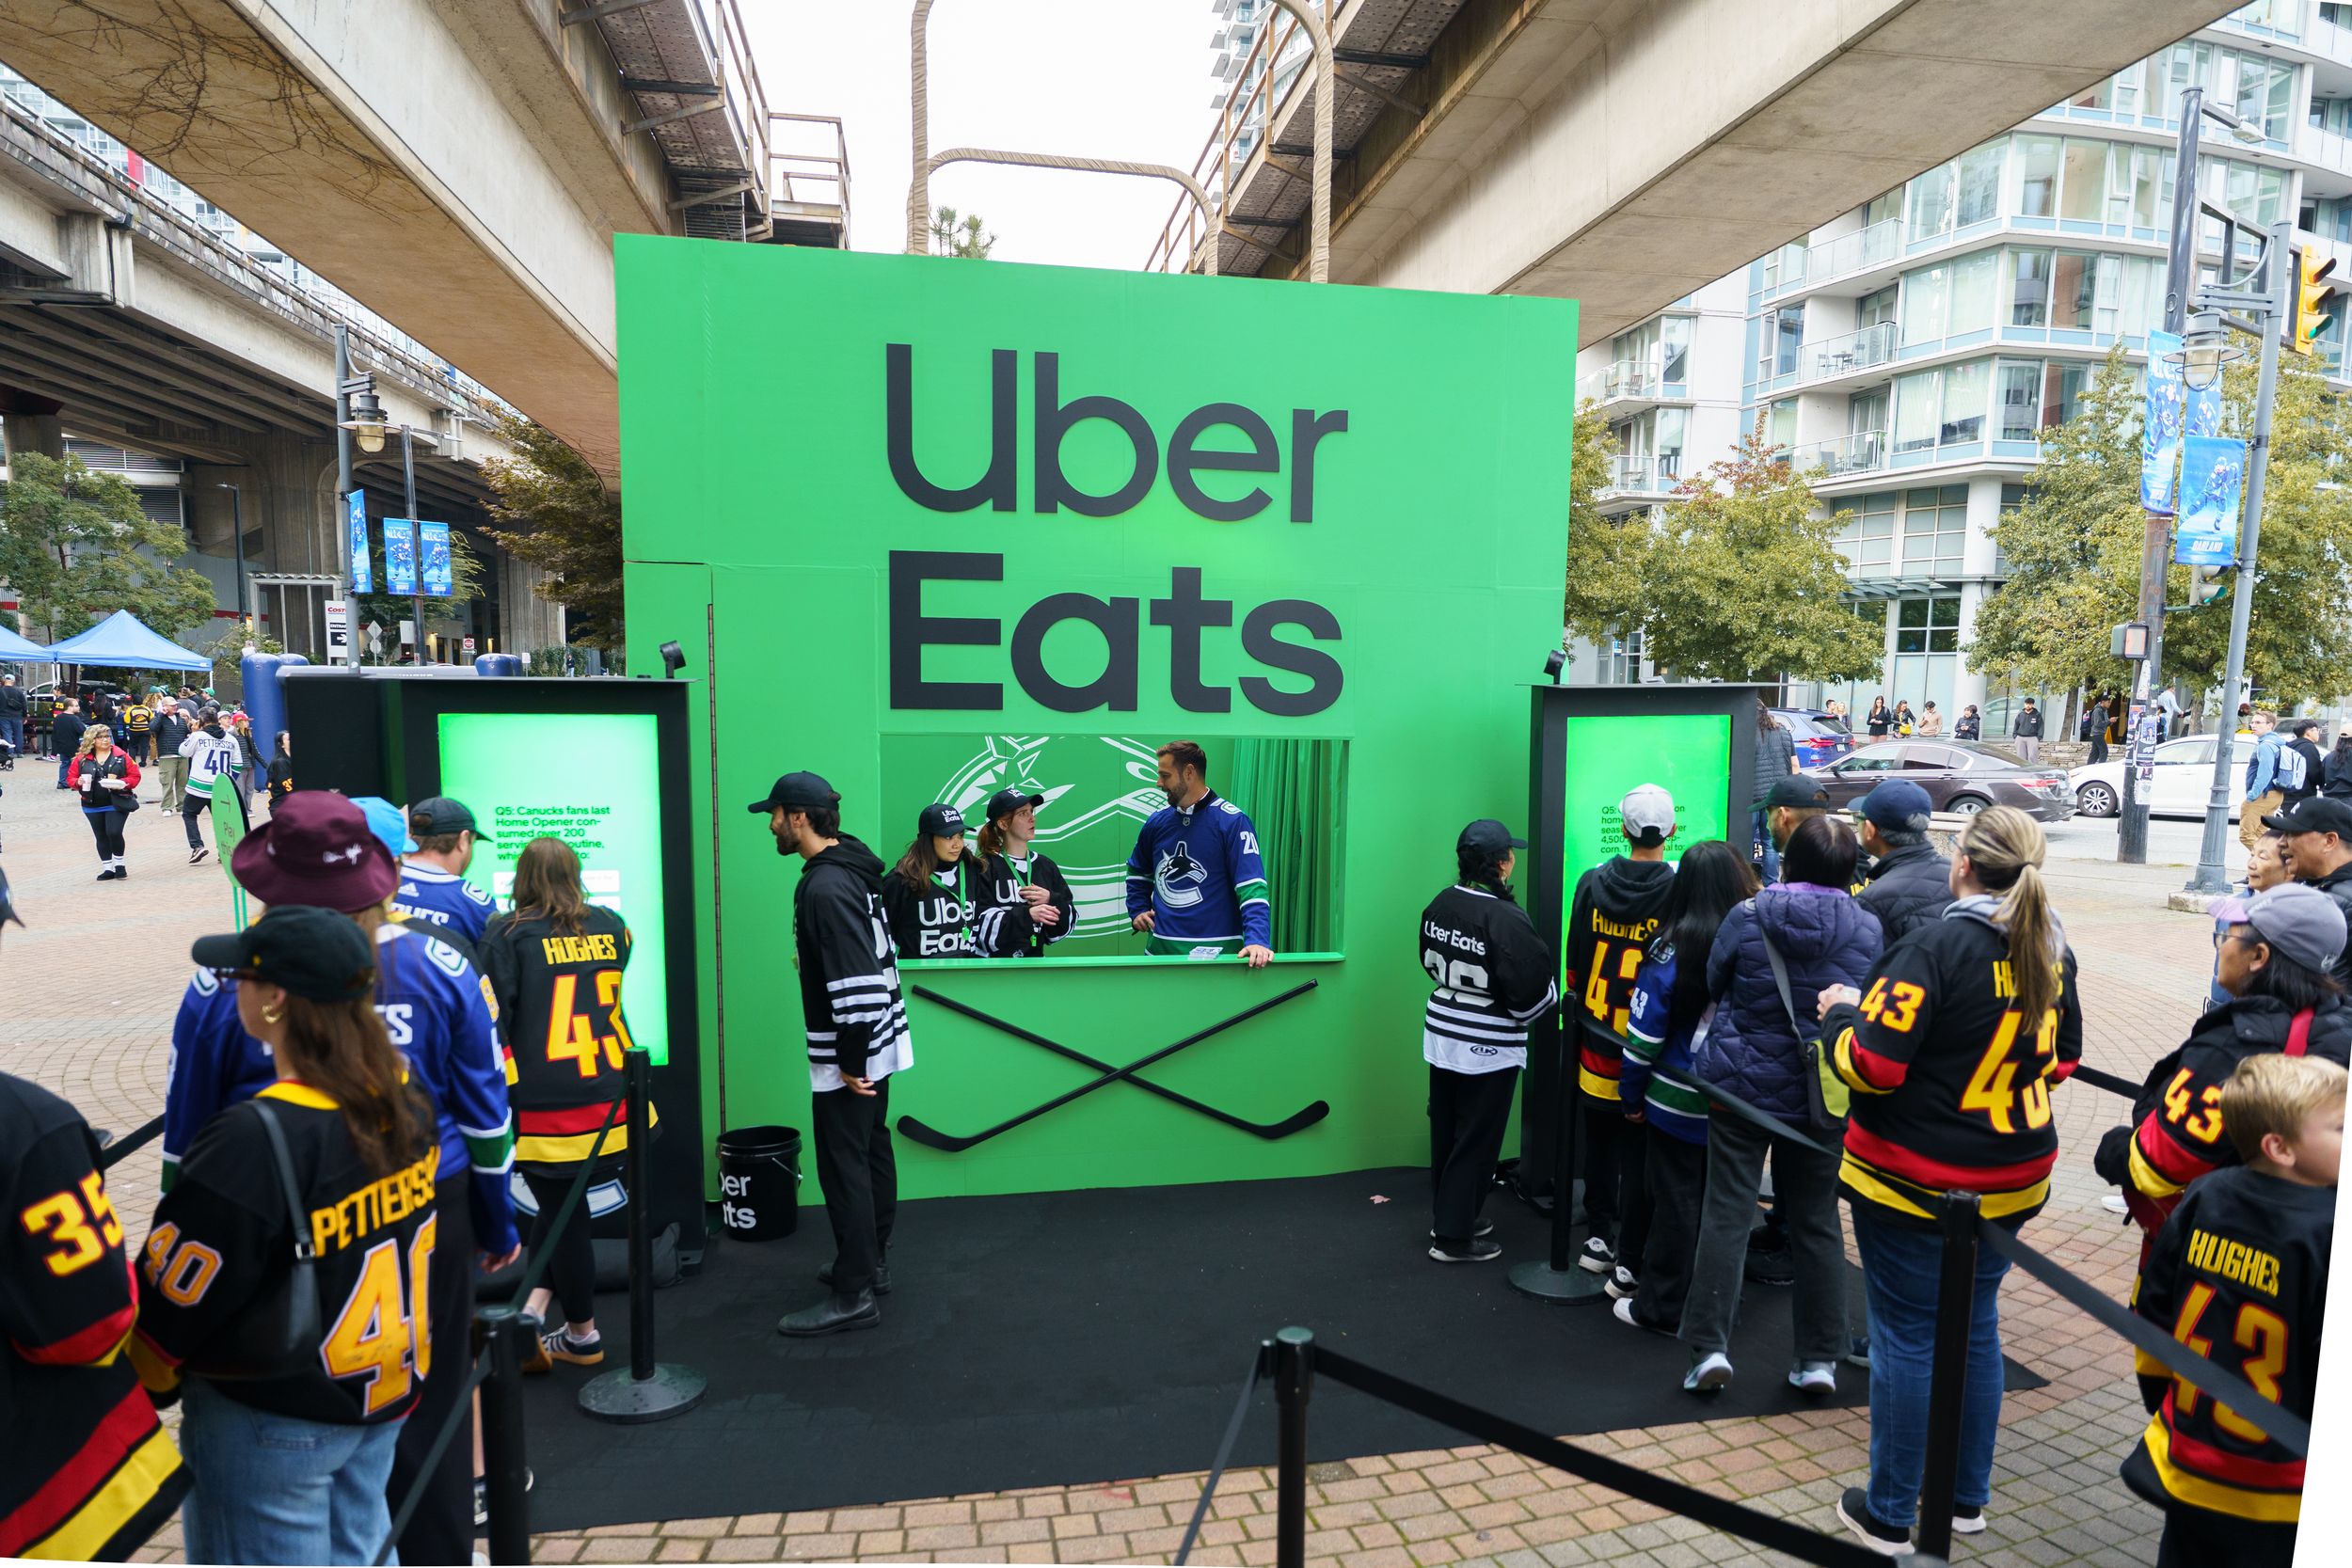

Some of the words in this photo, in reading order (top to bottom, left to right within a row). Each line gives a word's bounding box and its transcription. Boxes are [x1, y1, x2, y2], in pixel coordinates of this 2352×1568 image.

[886, 342, 1349, 523] Uber
[889, 549, 1344, 717] Eats
[204, 750, 230, 776] 40
[495, 806, 516, 816] Q5:
[516, 806, 564, 816] Canucks
[566, 806, 590, 815] fans
[591, 805, 611, 815] last
[495, 817, 529, 827] Home
[532, 817, 573, 828] Opener
[942, 809, 958, 817] Uber
[944, 815, 961, 823] Eats
[1601, 806, 1616, 815] Q5:
[496, 829, 534, 838] sumed
[564, 828, 585, 837] 200
[1240, 831, 1260, 855] 20
[1601, 835, 1625, 845] 4,500
[1666, 835, 1681, 845] op-
[995, 879, 1028, 904] Ub
[542, 934, 617, 965] HUGHES
[1424, 920, 1451, 943] Uber
[1451, 928, 1486, 956] Eats
[1629, 987, 1649, 1020] 43
[1859, 976, 1927, 1033] 43
[546, 969, 635, 1079] 43
[1959, 1008, 2058, 1133] 43
[2164, 1066, 2224, 1145] 43
[310, 1145, 441, 1259] PETTERS
[21, 1169, 125, 1278] 35
[143, 1221, 224, 1307] 40
[2185, 1227, 2280, 1298] HUGHES
[2171, 1280, 2291, 1447] 43
